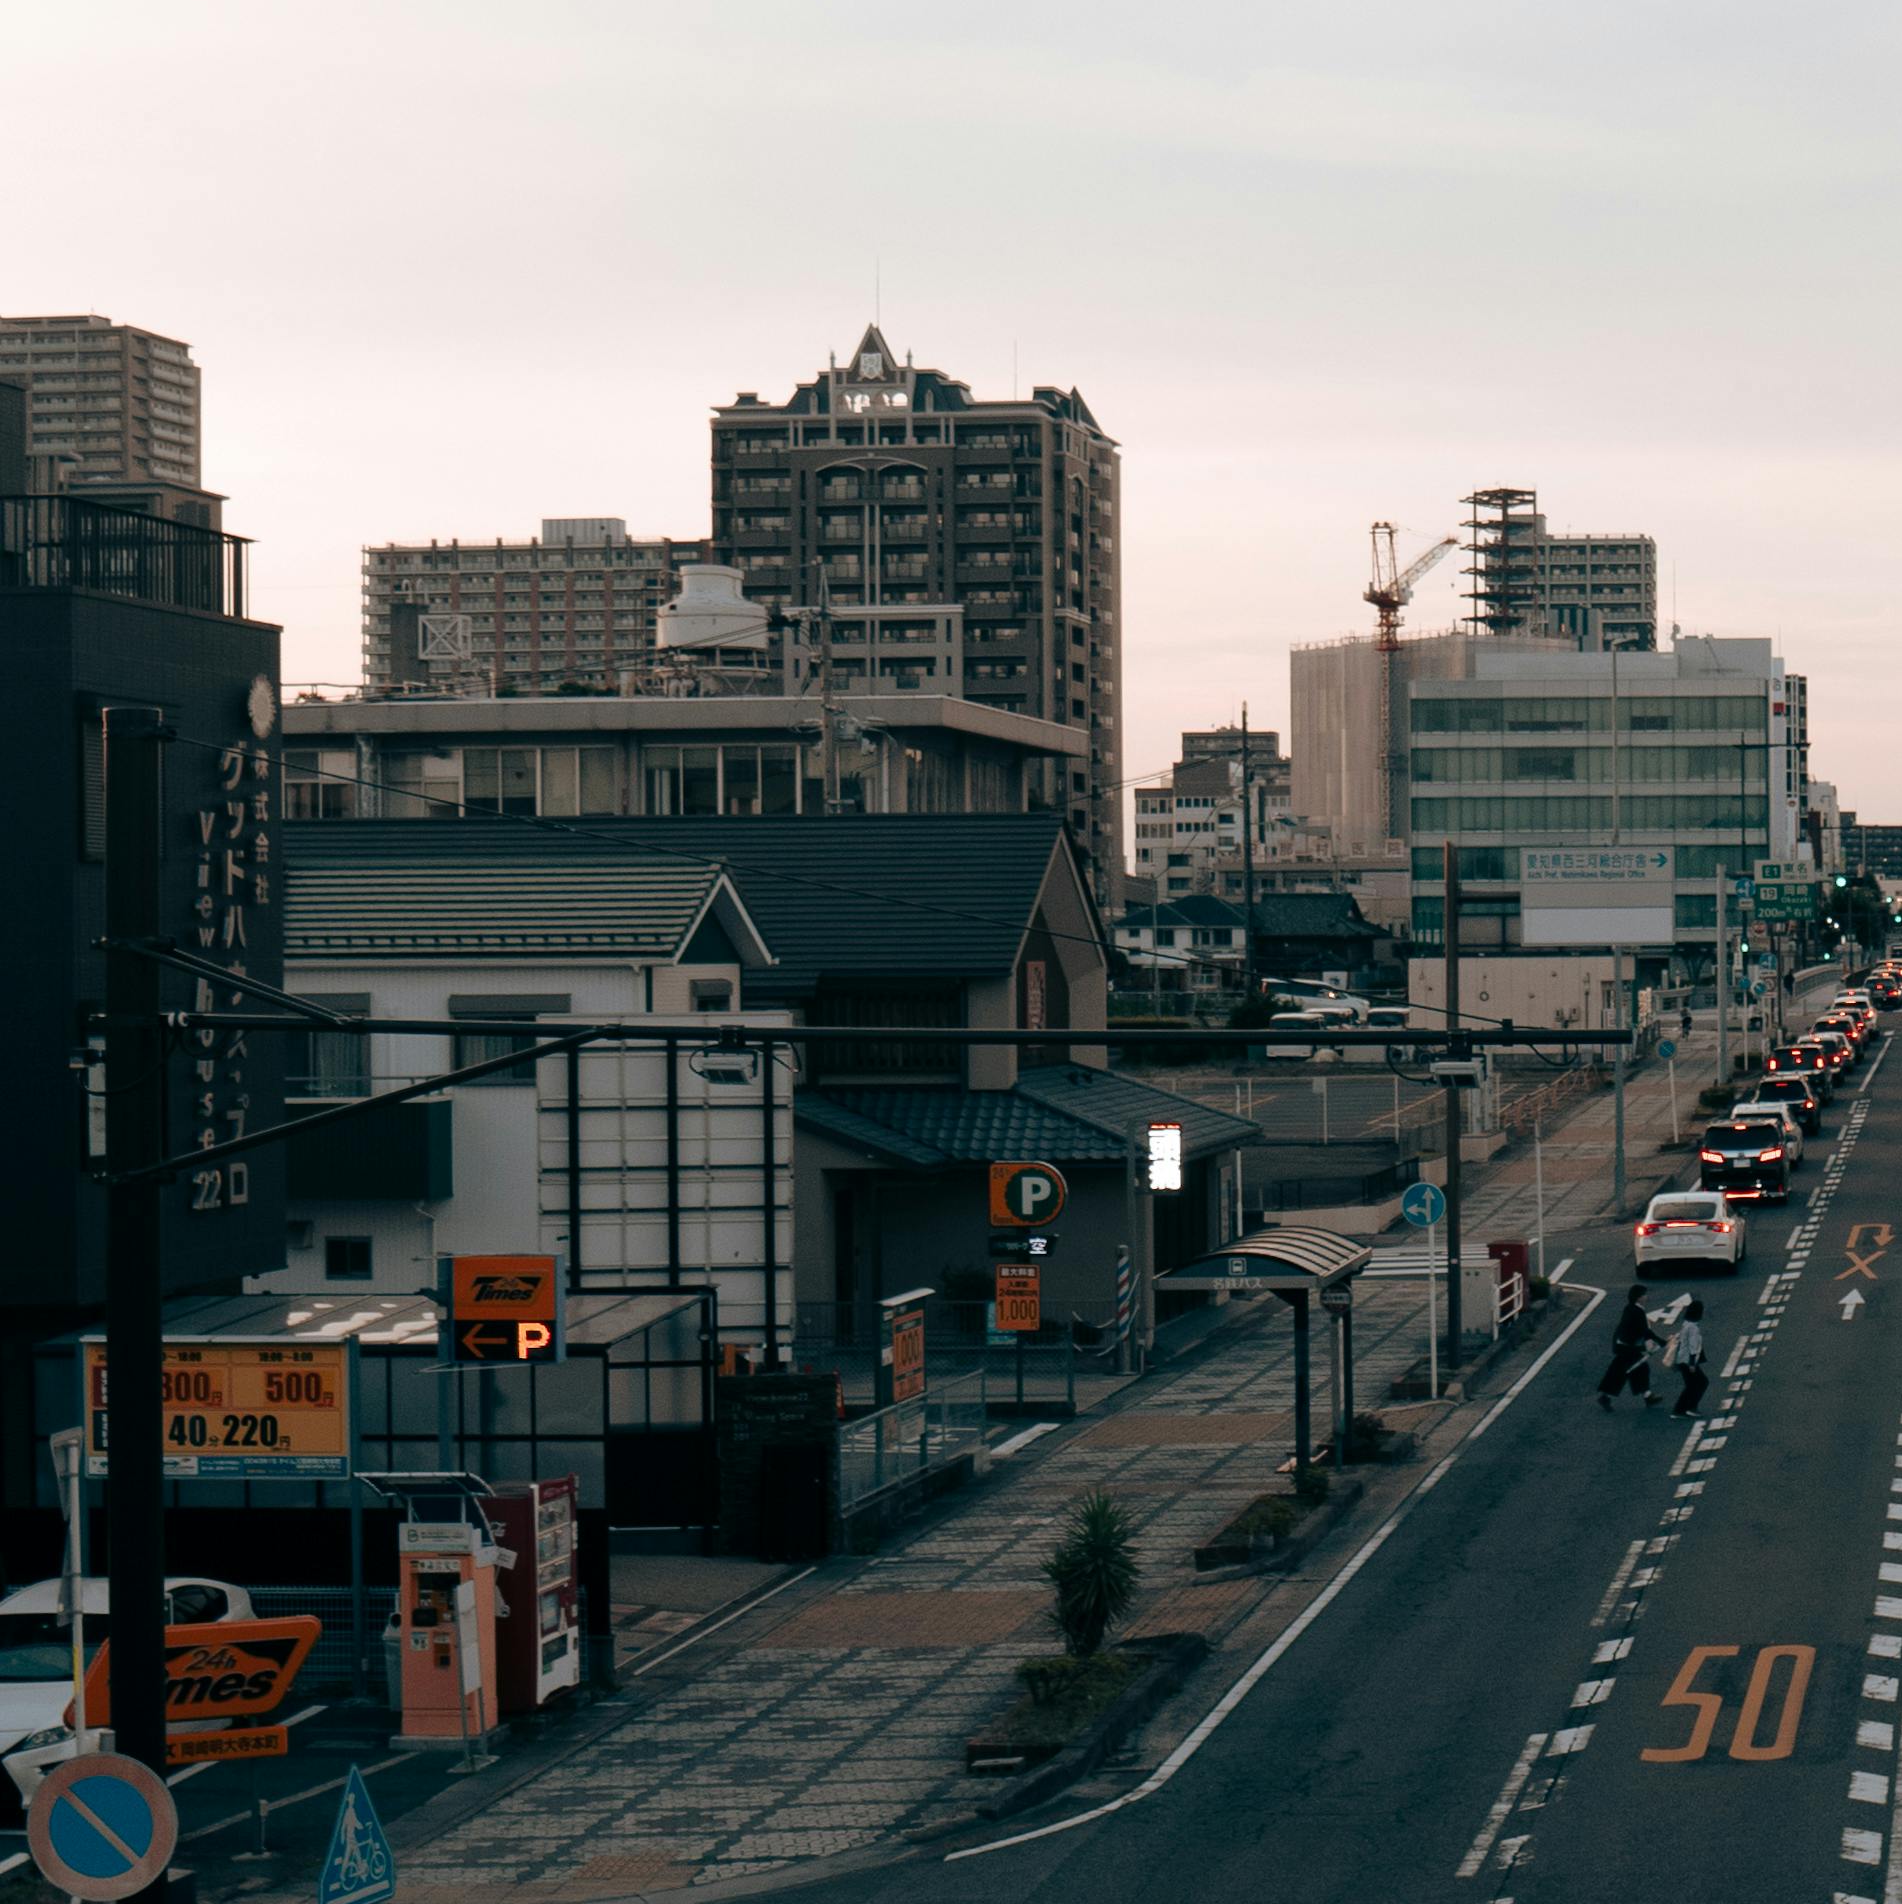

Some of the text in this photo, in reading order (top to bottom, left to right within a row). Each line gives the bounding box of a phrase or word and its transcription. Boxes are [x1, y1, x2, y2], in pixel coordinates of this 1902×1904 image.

[255, 749, 270, 905] 株式会社
[1627, 870, 1646, 878] Office
[1021, 1177, 1052, 1215] P
[1029, 1238, 1047, 1255] 空
[473, 1277, 535, 1302] Times
[1213, 1278, 1265, 1290] 名鉄バス
[998, 1300, 1038, 1322] 1,000
[517, 1322, 551, 1360] P
[186, 1649, 238, 1672] 24h
[164, 1668, 277, 1706] mes
[1639, 1644, 1817, 1763] 50
[182, 1734, 279, 1760] 岡崎明大寺本町
